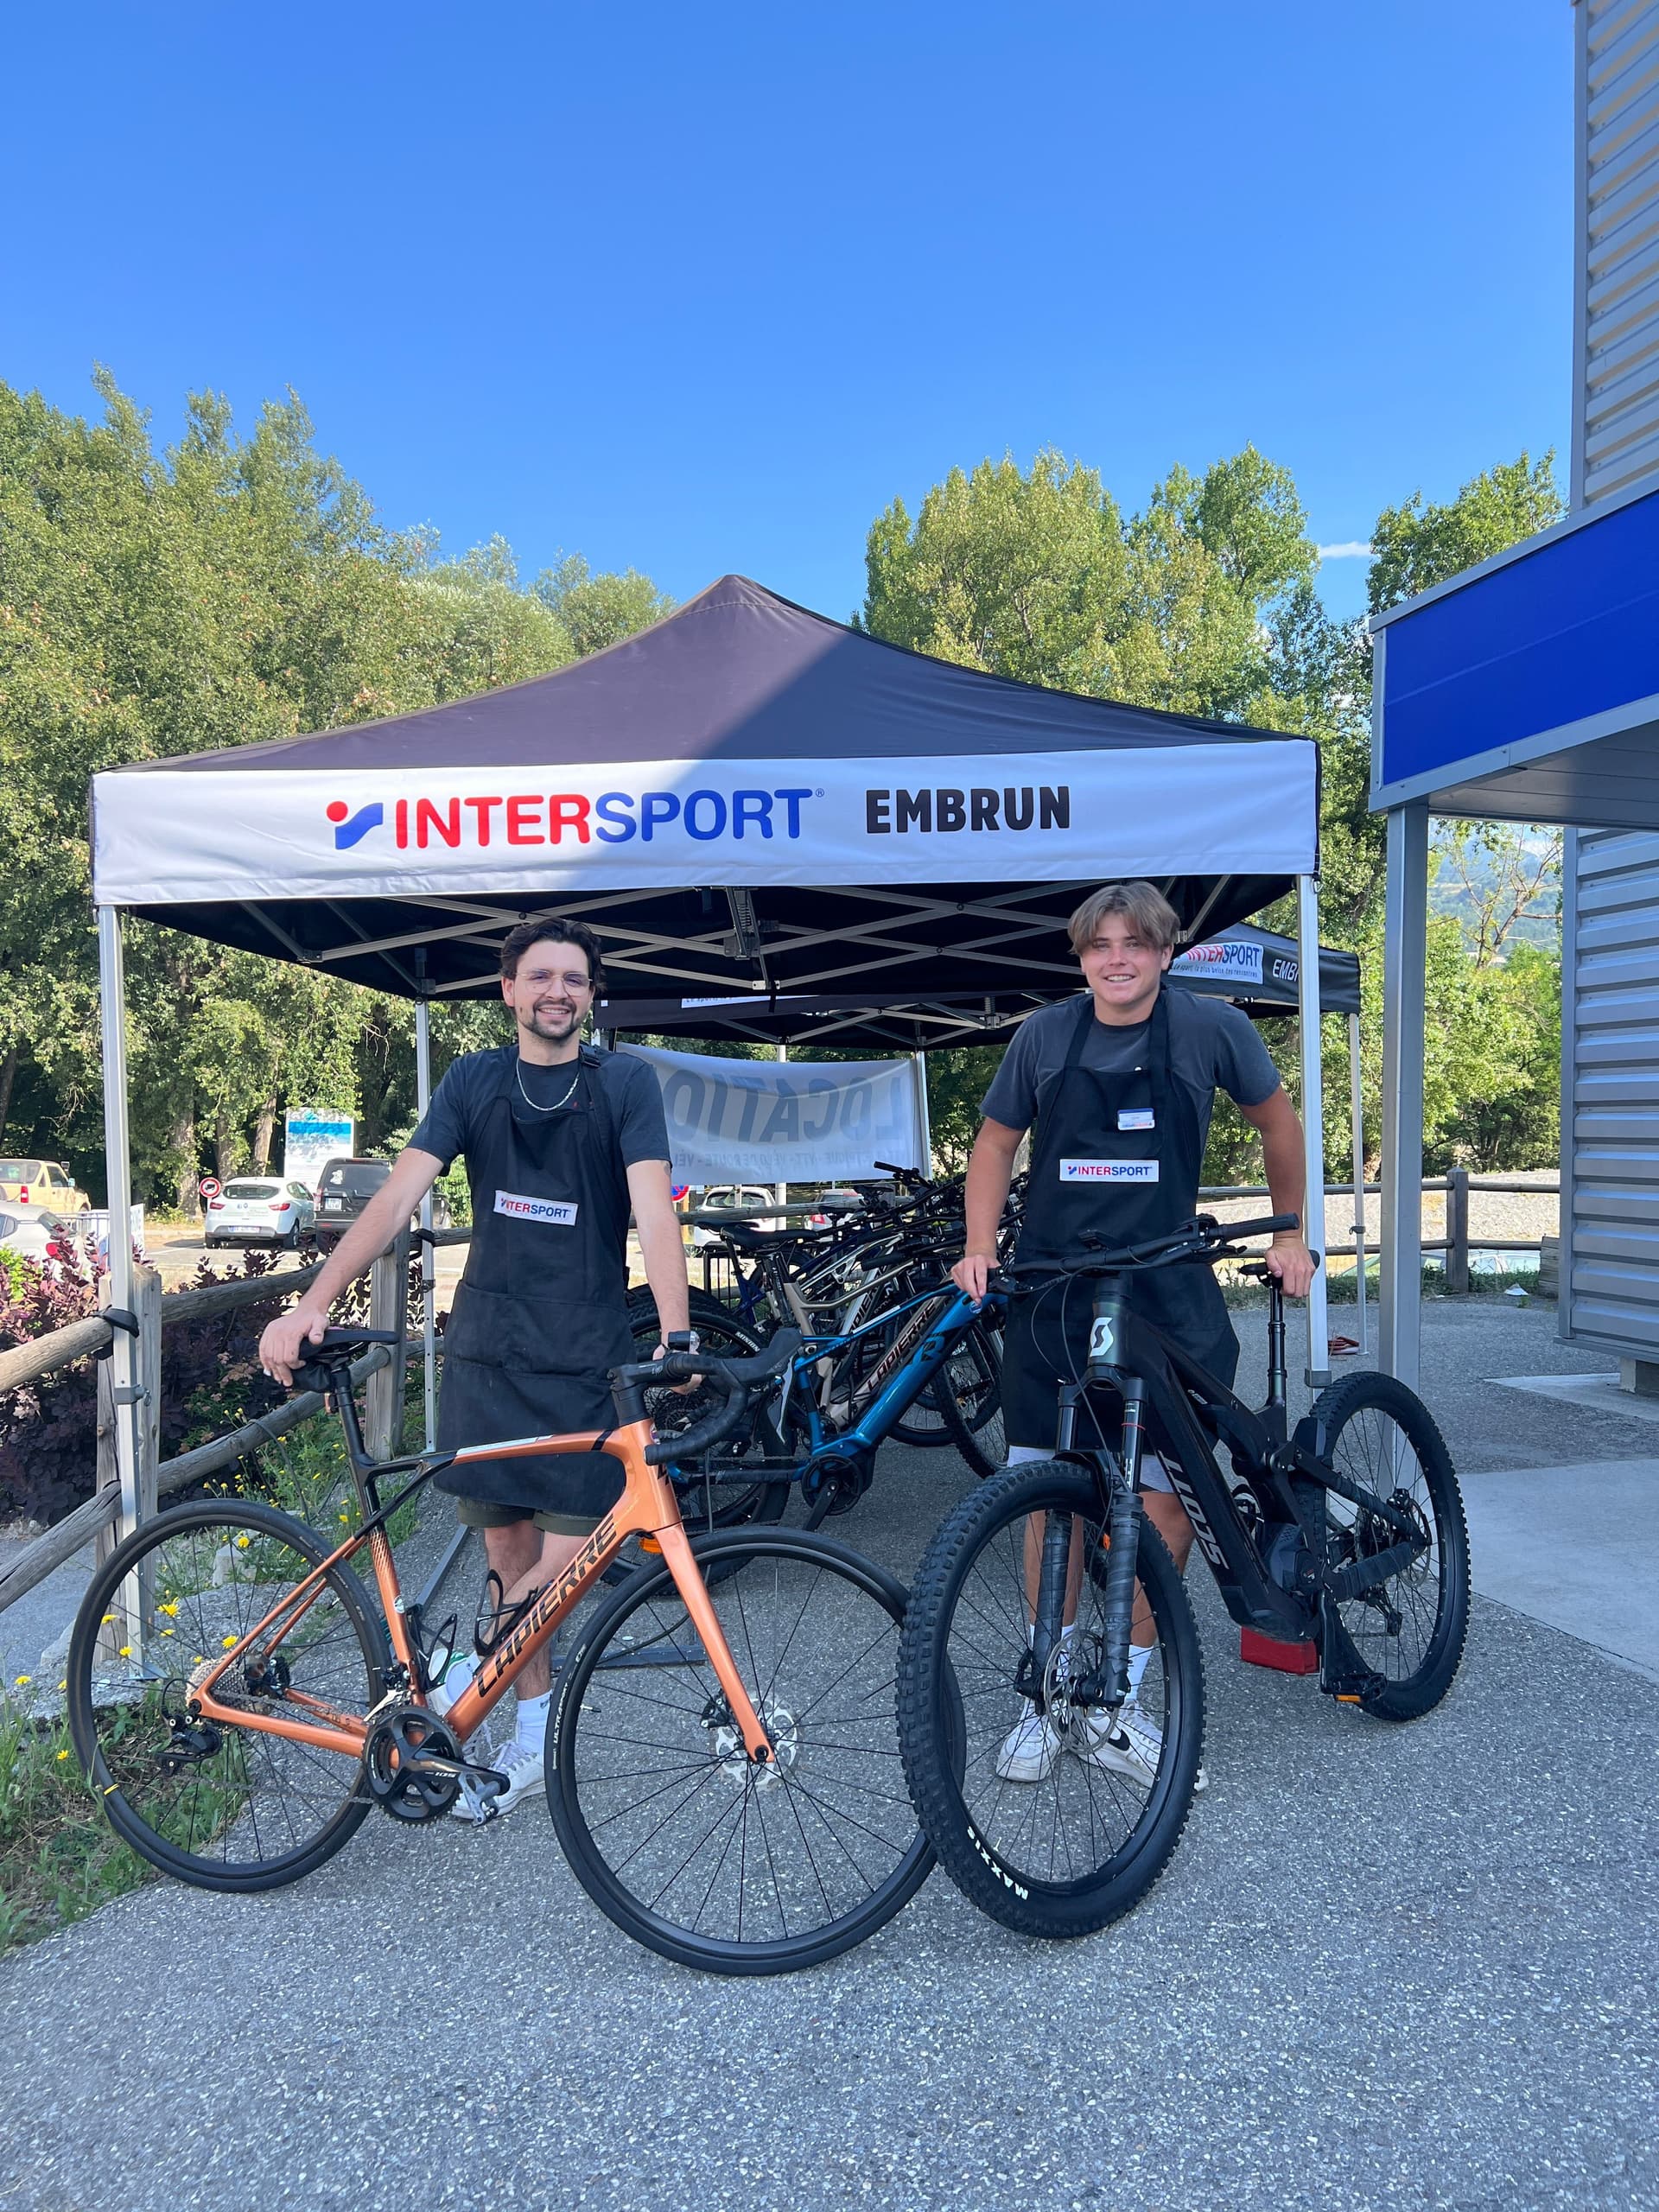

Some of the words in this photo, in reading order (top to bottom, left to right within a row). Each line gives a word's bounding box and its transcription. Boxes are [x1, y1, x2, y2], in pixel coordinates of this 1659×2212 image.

[396, 789, 813, 849] INTERSPORT
[866, 786, 1070, 834] EMBRUN
[1187, 945, 1259, 967] INTERSPORT
[1078, 1166, 1149, 1176] INTERSPORT
[868, 1302, 937, 1391] LAPIERRE
[1158, 1450, 1230, 1570] SCOTT
[477, 1513, 617, 1698] LAPIERRE
[968, 1826, 1028, 1900] MAXXIS
